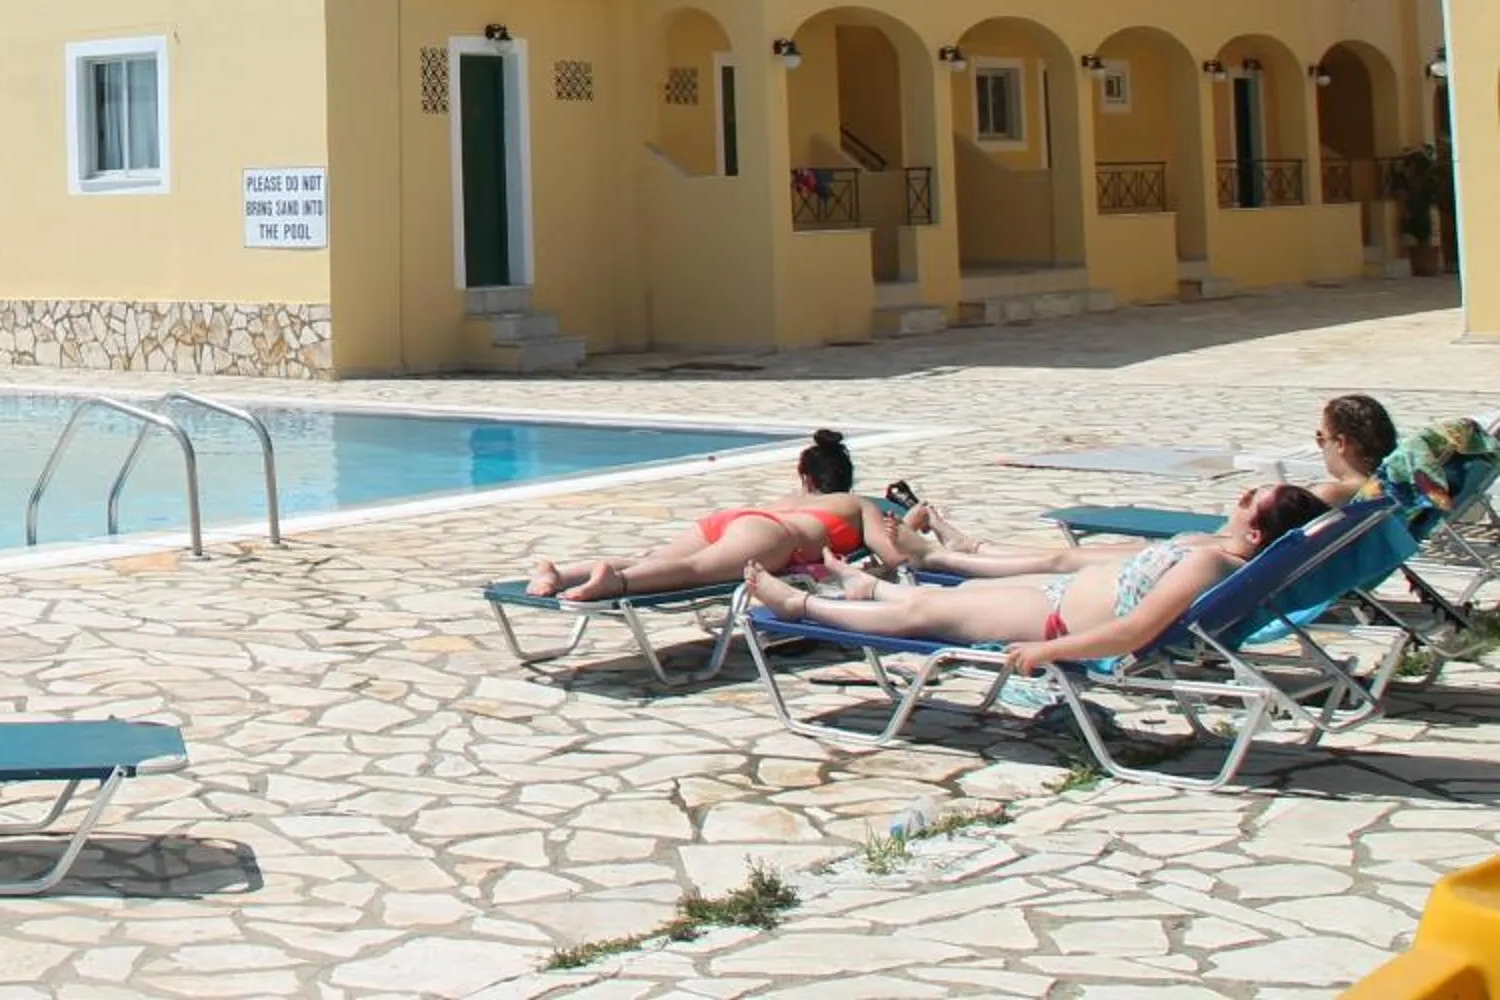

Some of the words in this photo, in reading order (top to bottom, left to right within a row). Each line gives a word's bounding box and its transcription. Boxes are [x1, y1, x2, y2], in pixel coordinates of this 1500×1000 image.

[247, 175, 283, 193] PLEASE
[286, 175, 299, 192] DO
[302, 174, 322, 191] NOT
[245, 199, 273, 217] BRING
[276, 199, 299, 217] SAND
[302, 199, 324, 217] INTO
[260, 223, 279, 240] THE
[283, 223, 313, 241] POOL
